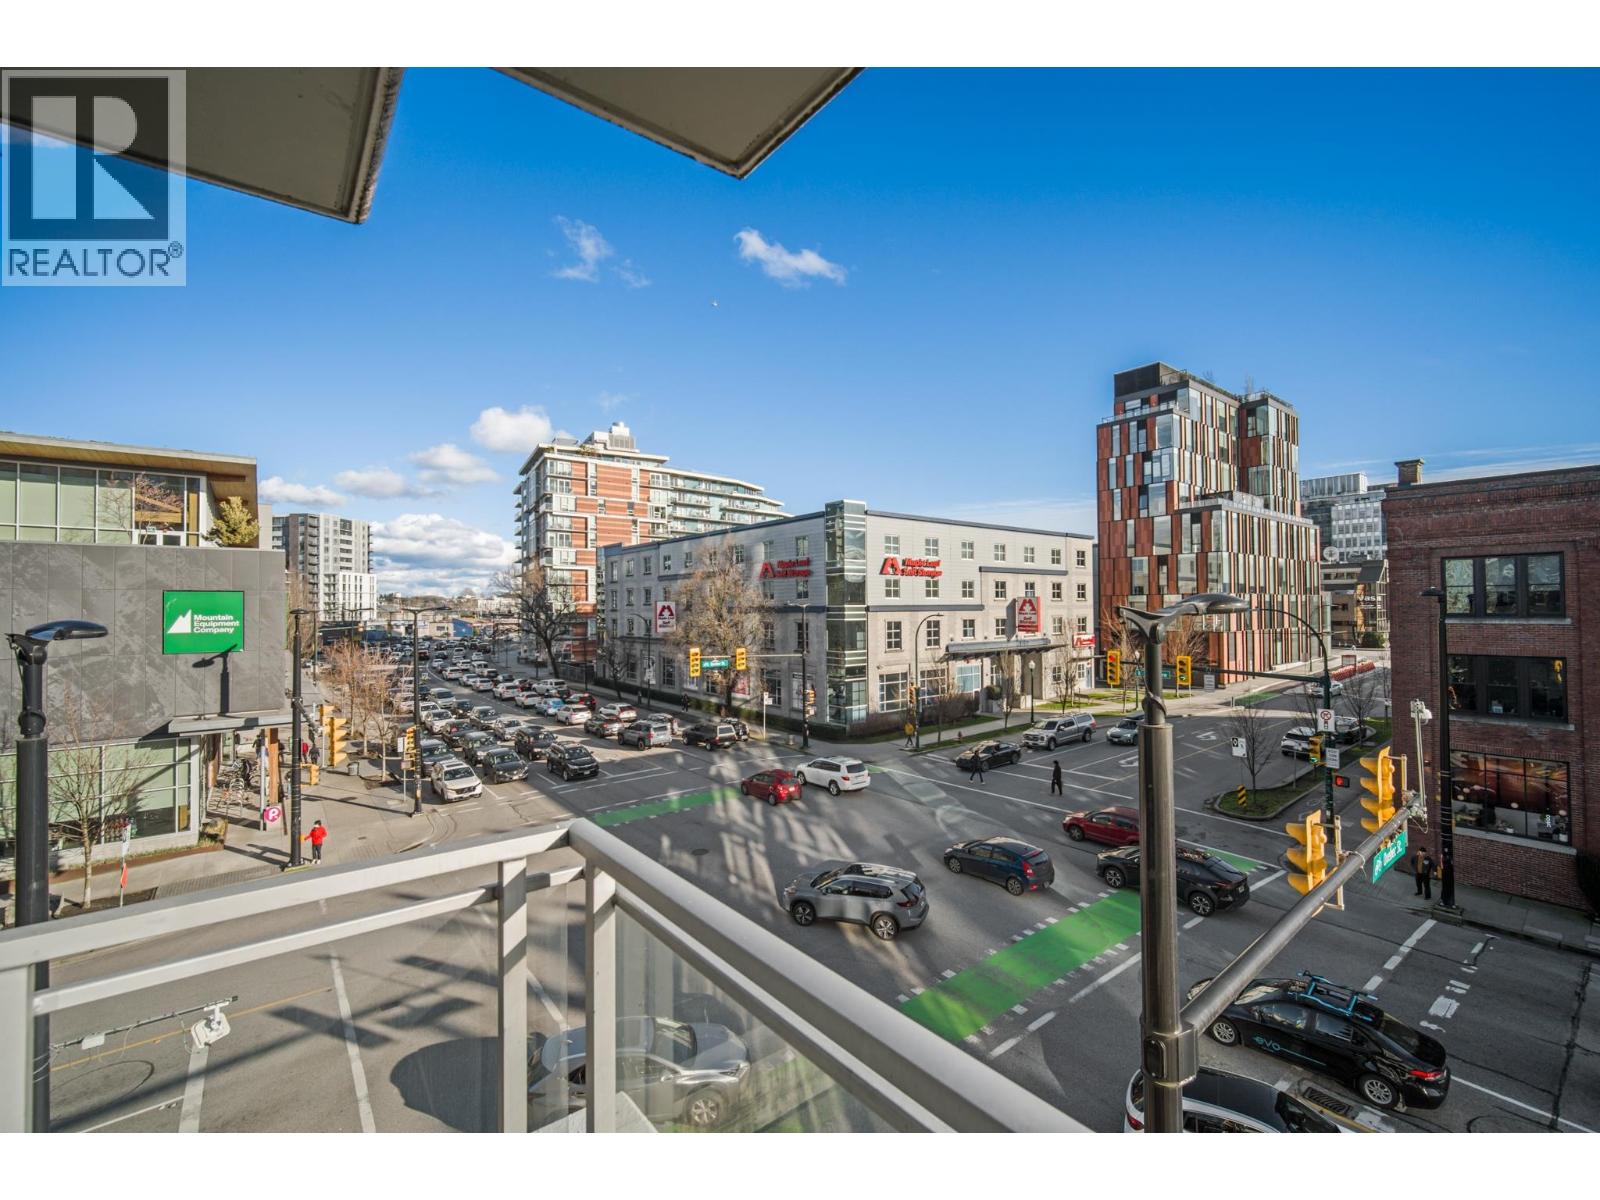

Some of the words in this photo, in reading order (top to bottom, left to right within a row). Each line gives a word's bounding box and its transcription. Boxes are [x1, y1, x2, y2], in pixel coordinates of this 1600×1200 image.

[193, 620, 240, 628] Equipment
[193, 626, 235, 634] Company
[1252, 1036, 1281, 1051] evo
